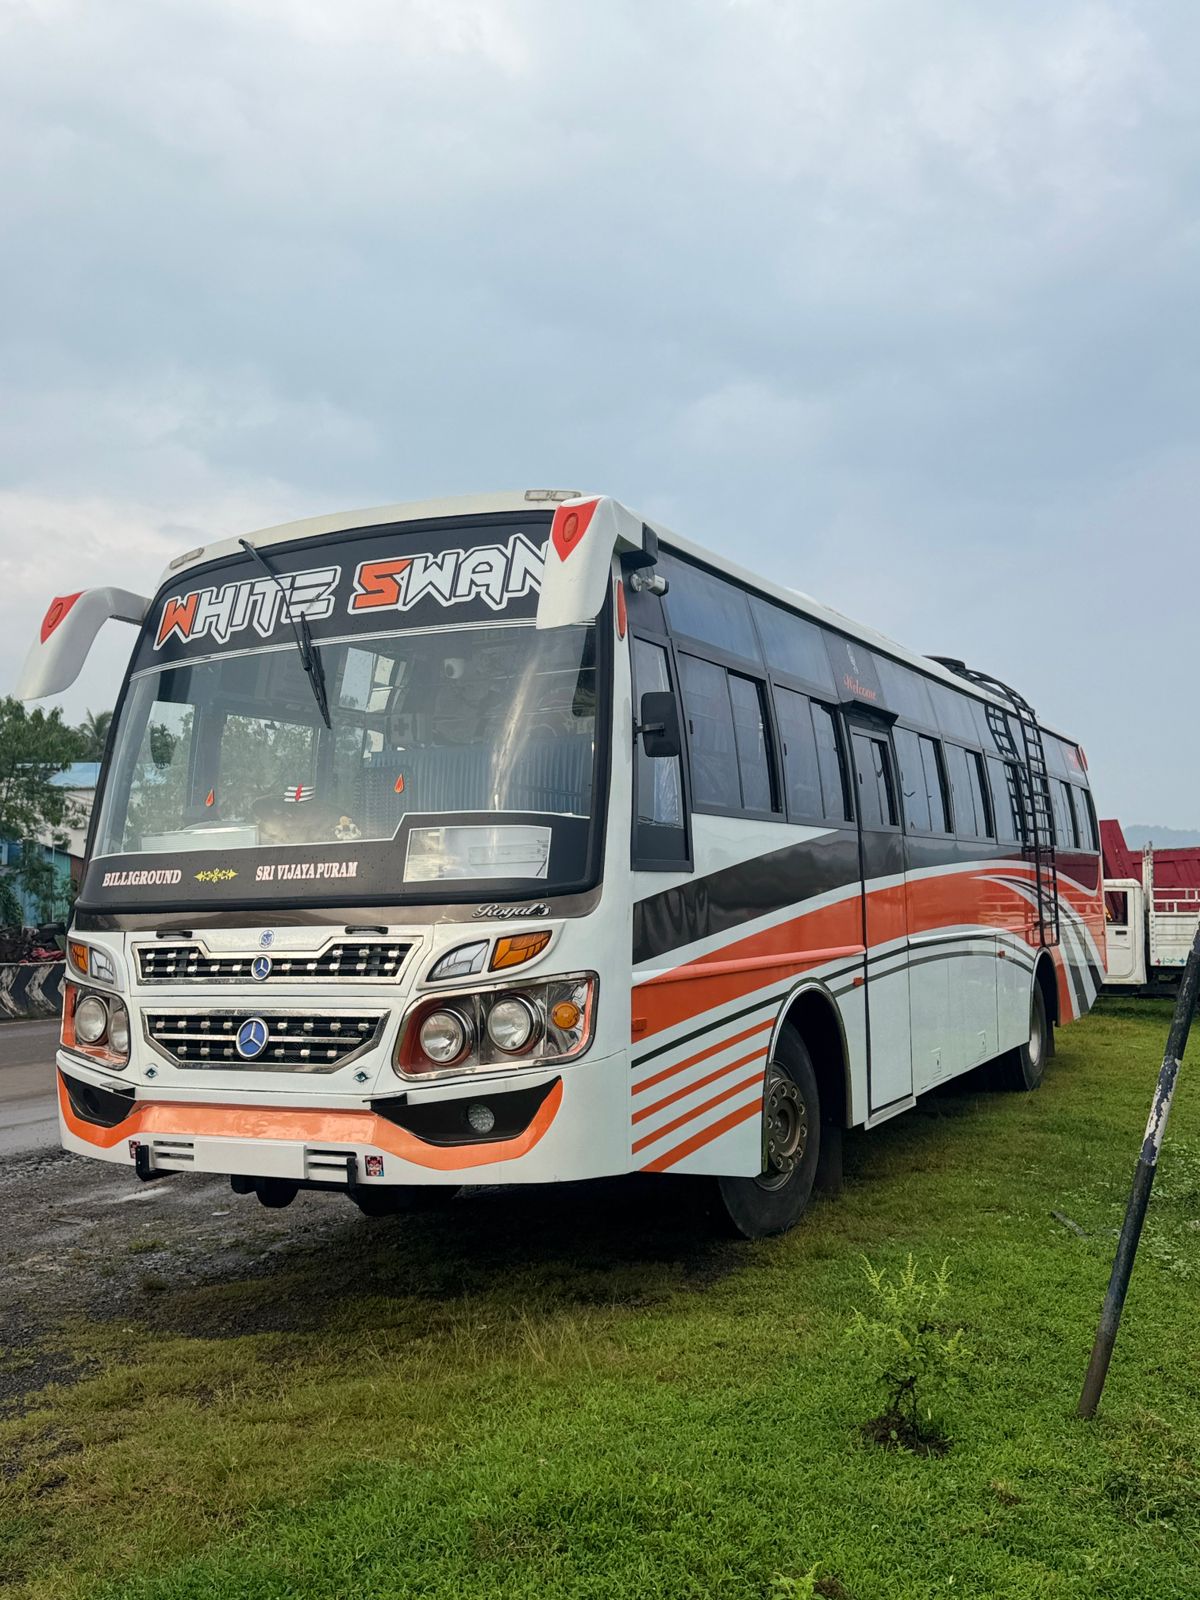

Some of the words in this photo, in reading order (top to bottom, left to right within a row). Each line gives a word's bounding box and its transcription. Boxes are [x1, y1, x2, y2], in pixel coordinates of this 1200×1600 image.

[153, 566, 341, 650] WHITE
[348, 533, 550, 614] SWAN
[102, 869, 182, 887] BILLIGROUND
[256, 865, 275, 881] SRI
[472, 903, 551, 919] Royal's
